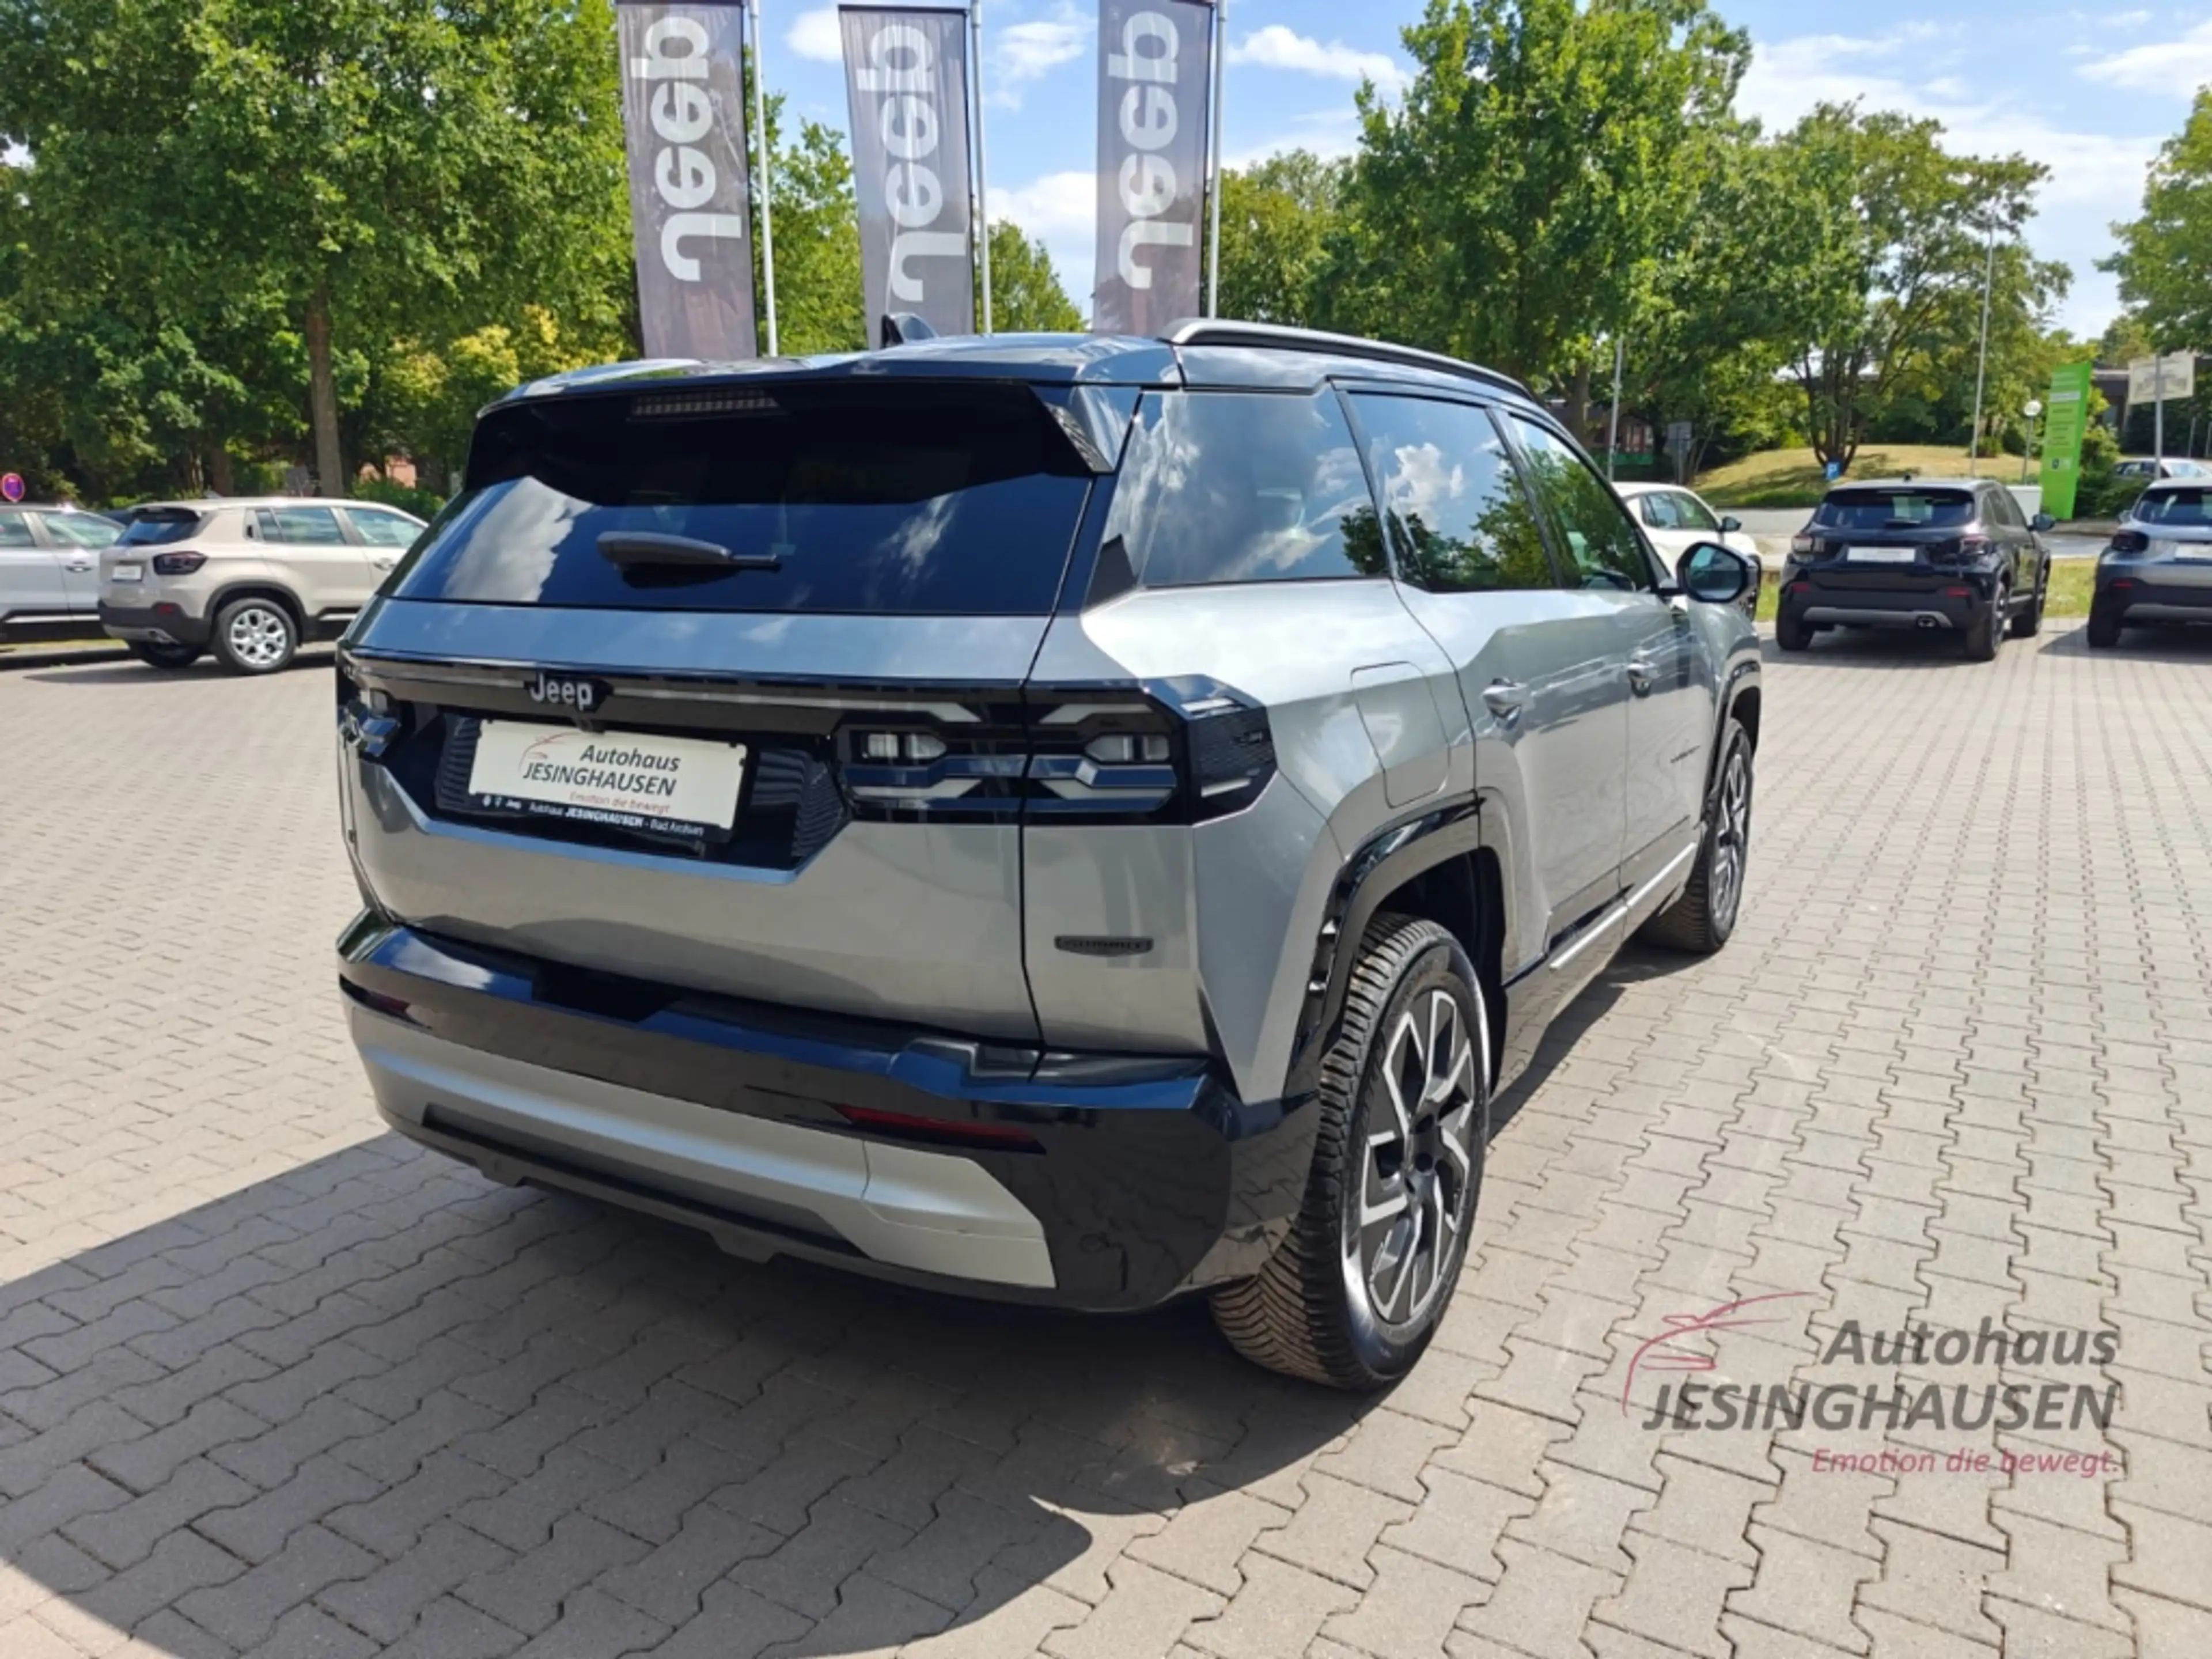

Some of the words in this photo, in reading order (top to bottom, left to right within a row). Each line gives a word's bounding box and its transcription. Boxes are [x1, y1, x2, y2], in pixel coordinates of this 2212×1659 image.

[529, 673, 593, 711] Jeep
[579, 745, 681, 772] Autohaus
[523, 762, 677, 797] JESINGHAUSEN
